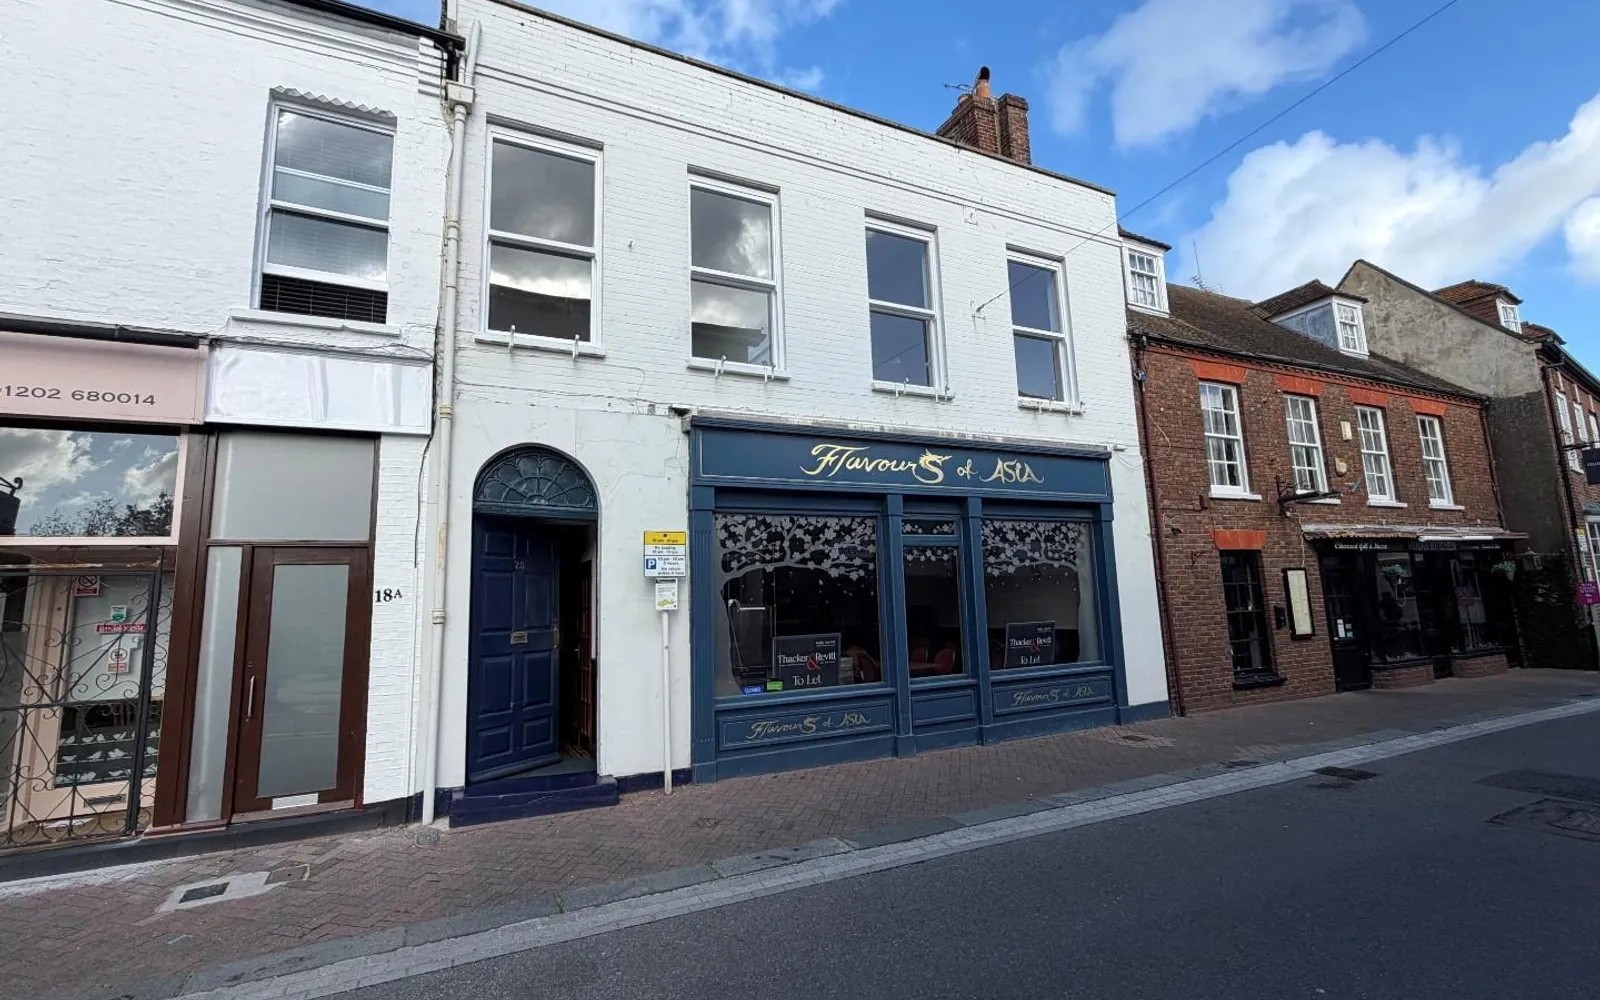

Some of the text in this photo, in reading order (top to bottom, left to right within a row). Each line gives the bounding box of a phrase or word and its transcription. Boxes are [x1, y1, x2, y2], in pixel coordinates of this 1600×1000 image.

[0, 385, 156, 405] 1202 680014
[957, 458, 978, 480] of
[375, 588, 402, 603] 18A
[777, 653, 808, 664] Thacker
[806, 654, 821, 670] &
[1020, 655, 1040, 664] To Let
[792, 675, 804, 686] To
[806, 674, 822, 685] Let
